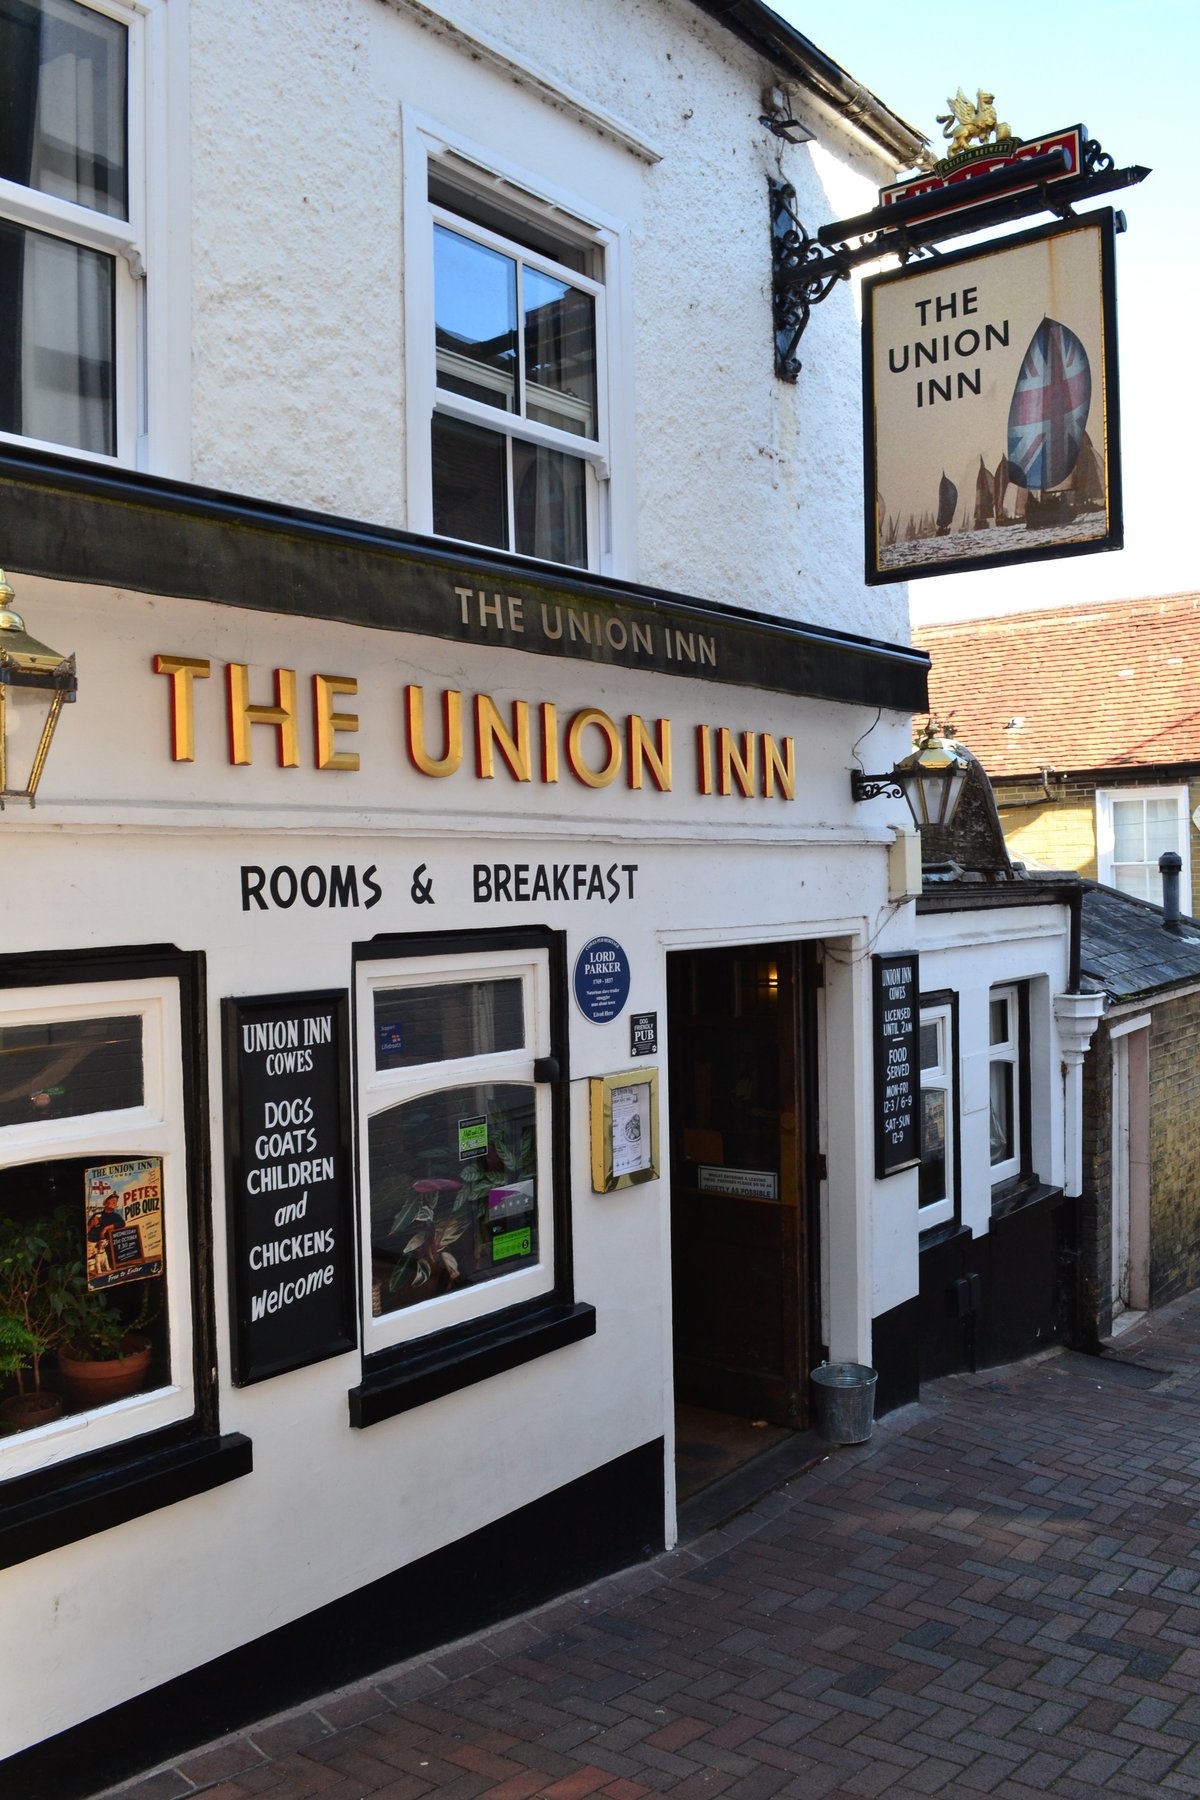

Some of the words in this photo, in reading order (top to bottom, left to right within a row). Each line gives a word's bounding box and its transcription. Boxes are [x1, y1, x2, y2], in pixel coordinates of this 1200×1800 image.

[944, 152, 972, 170] GRIFFIN
[975, 145, 1007, 157] BREWERY
[915, 286, 978, 326] THE
[888, 320, 1010, 373] UNION
[916, 368, 981, 408] INN
[454, 586, 524, 633] THE
[540, 603, 654, 656] UNION
[664, 628, 717, 666] INN
[154, 654, 358, 771] THE
[405, 684, 672, 793] UNION
[696, 723, 794, 801] INN
[240, 864, 382, 911] ROOMS
[410, 863, 435, 904] &
[472, 863, 638, 904] BREAKFAST
[590, 951, 615, 962] LORD
[585, 962, 621, 974] PARKER
[882, 968, 900, 986] UNION
[902, 967, 912, 983] INN
[889, 986, 906, 1000] COWES
[885, 1007, 910, 1022] LICENSED
[242, 1020, 298, 1053] UNION
[303, 1016, 332, 1044] INN
[635, 1030, 654, 1041] PUB
[883, 1023, 899, 1036] UNTIL
[266, 1049, 313, 1076] COWES
[889, 1047, 907, 1064] FOOD
[887, 1063, 909, 1080] SERVED
[886, 1082, 908, 1098] MON-FRI
[264, 1097, 313, 1129] DOGS
[884, 1100, 895, 1113] 12-3
[901, 1095, 912, 1108] 6-9
[885, 1114, 910, 1133] SAT-SUN
[255, 1128, 317, 1160] GOATS
[892, 1131, 903, 1144] 12-9
[93, 1167, 106, 1178] THE
[110, 1164, 134, 1174] UNION
[138, 1161, 153, 1170] INN
[246, 1157, 334, 1195] CHILDREN
[123, 1186, 158, 1206] PETE'S
[704, 1184, 729, 1193] QUIETLY
[740, 1187, 771, 1198] POSSIBLE
[125, 1202, 141, 1221] PUB
[142, 1198, 160, 1213] QUIZ
[274, 1191, 307, 1227] and
[249, 1228, 334, 1271] CHICKENS
[523, 1240, 528, 1248] 5
[108, 1274, 119, 1282] Free
[127, 1266, 143, 1275] Enter
[251, 1264, 334, 1322] Welcome
